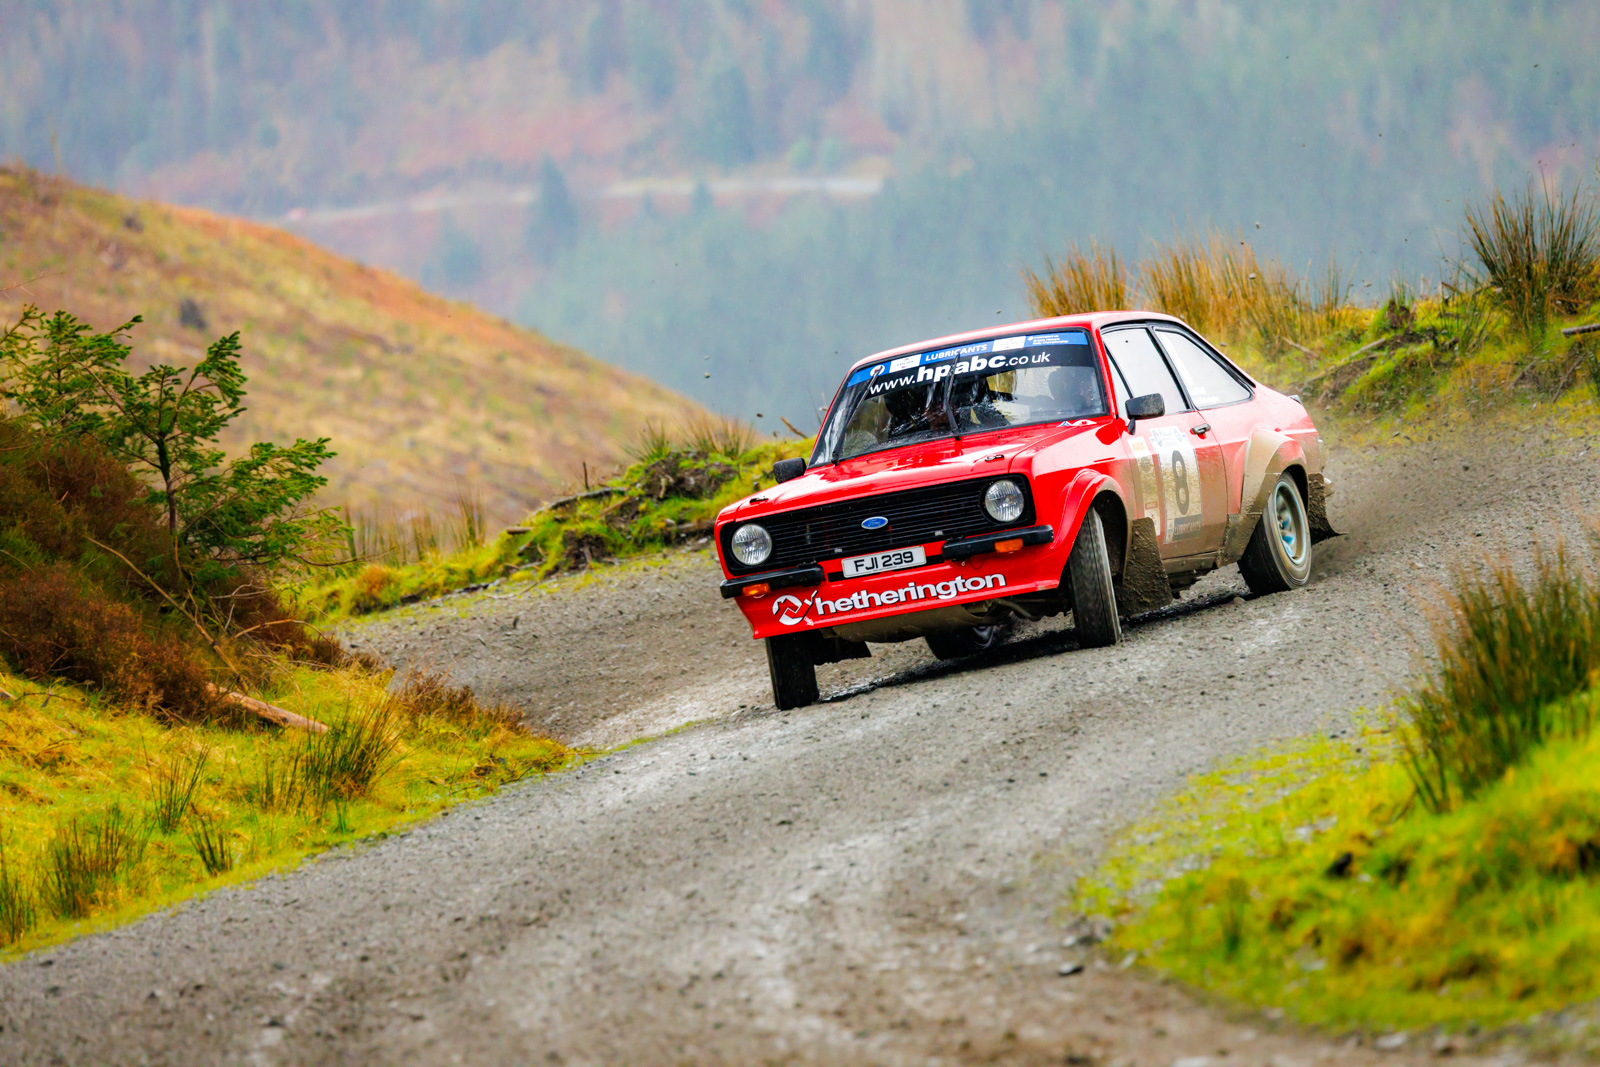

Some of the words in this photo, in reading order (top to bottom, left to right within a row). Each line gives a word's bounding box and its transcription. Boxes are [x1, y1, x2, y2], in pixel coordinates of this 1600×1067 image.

[925, 343, 988, 362] LUBRICANTS
[1171, 449, 1190, 516] 8
[853, 556, 879, 572] FJI
[881, 550, 914, 568] 239
[815, 573, 1007, 616] hetherington
